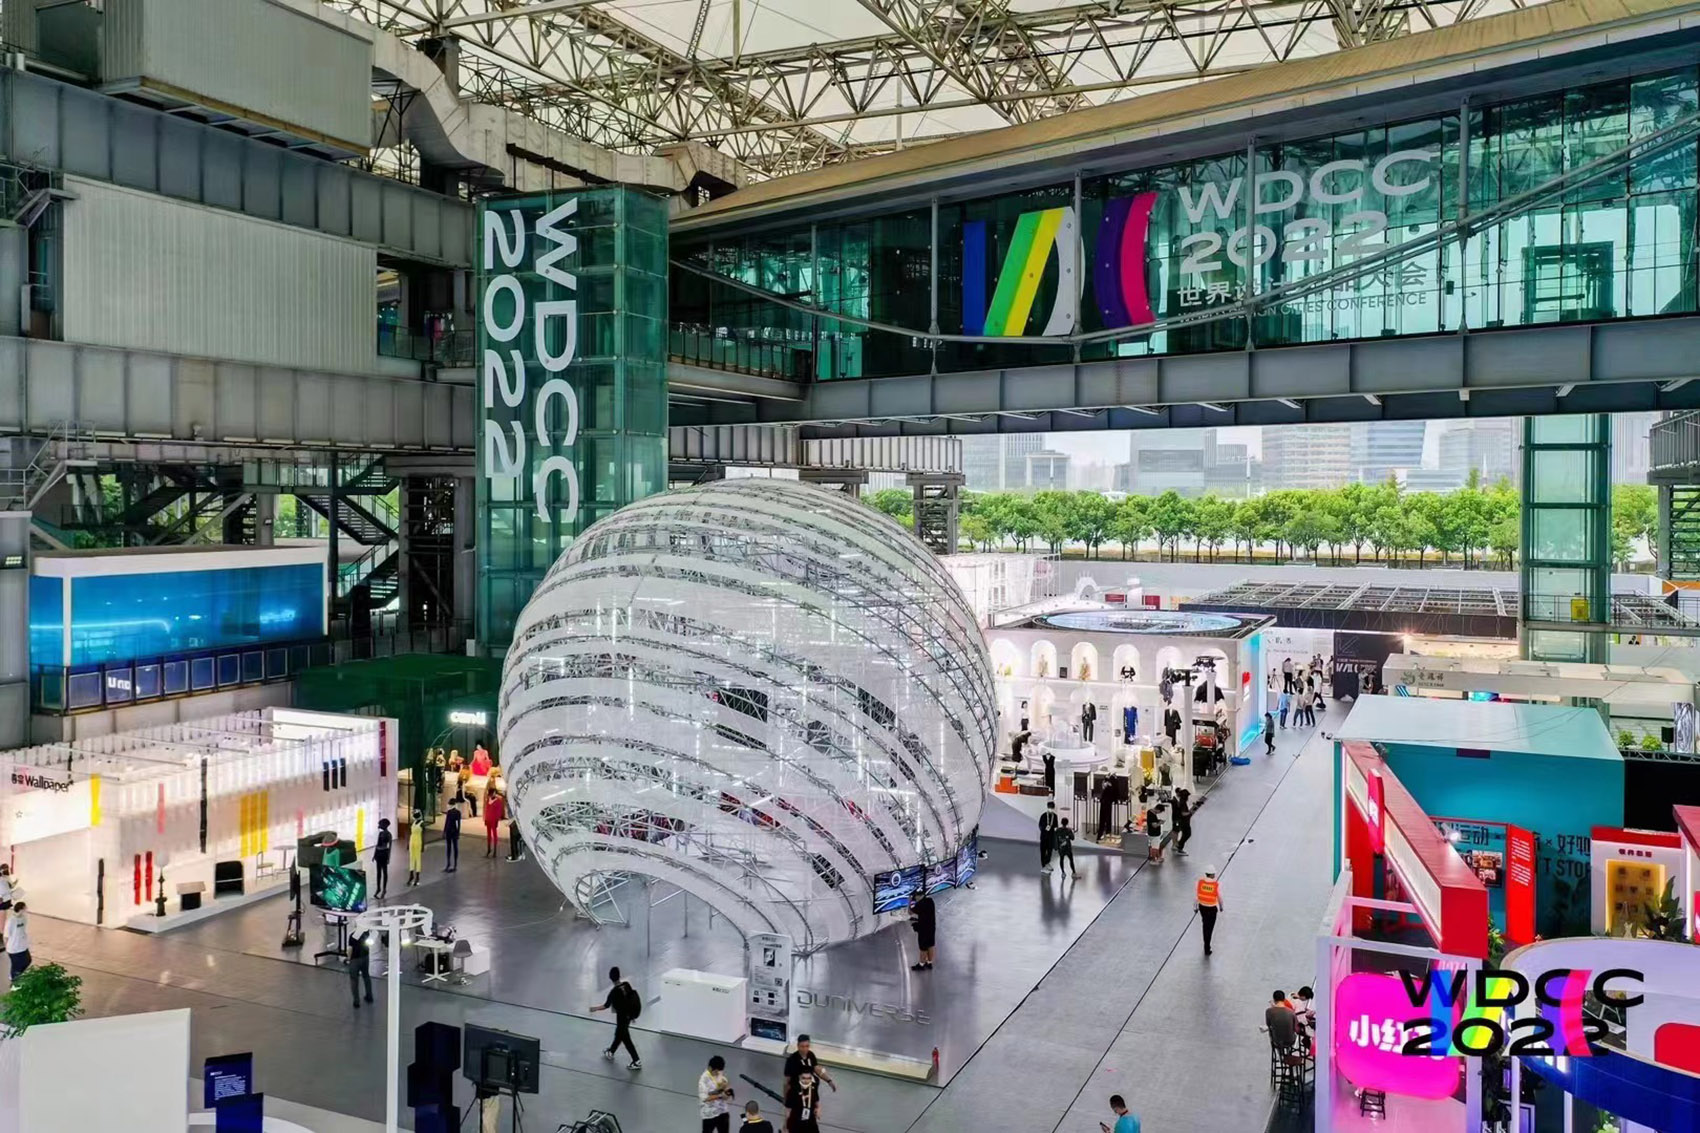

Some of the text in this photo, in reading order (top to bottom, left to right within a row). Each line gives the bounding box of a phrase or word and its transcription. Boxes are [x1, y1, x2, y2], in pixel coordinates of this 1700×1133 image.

[1178, 150, 1430, 223] WDCC
[1179, 210, 1388, 274] 2022
[1327, 292, 1427, 313] CONFERENCE
[484, 209, 525, 479] 2022
[535, 197, 579, 523] WDCC
[1349, 1014, 1446, 1060] 小红
